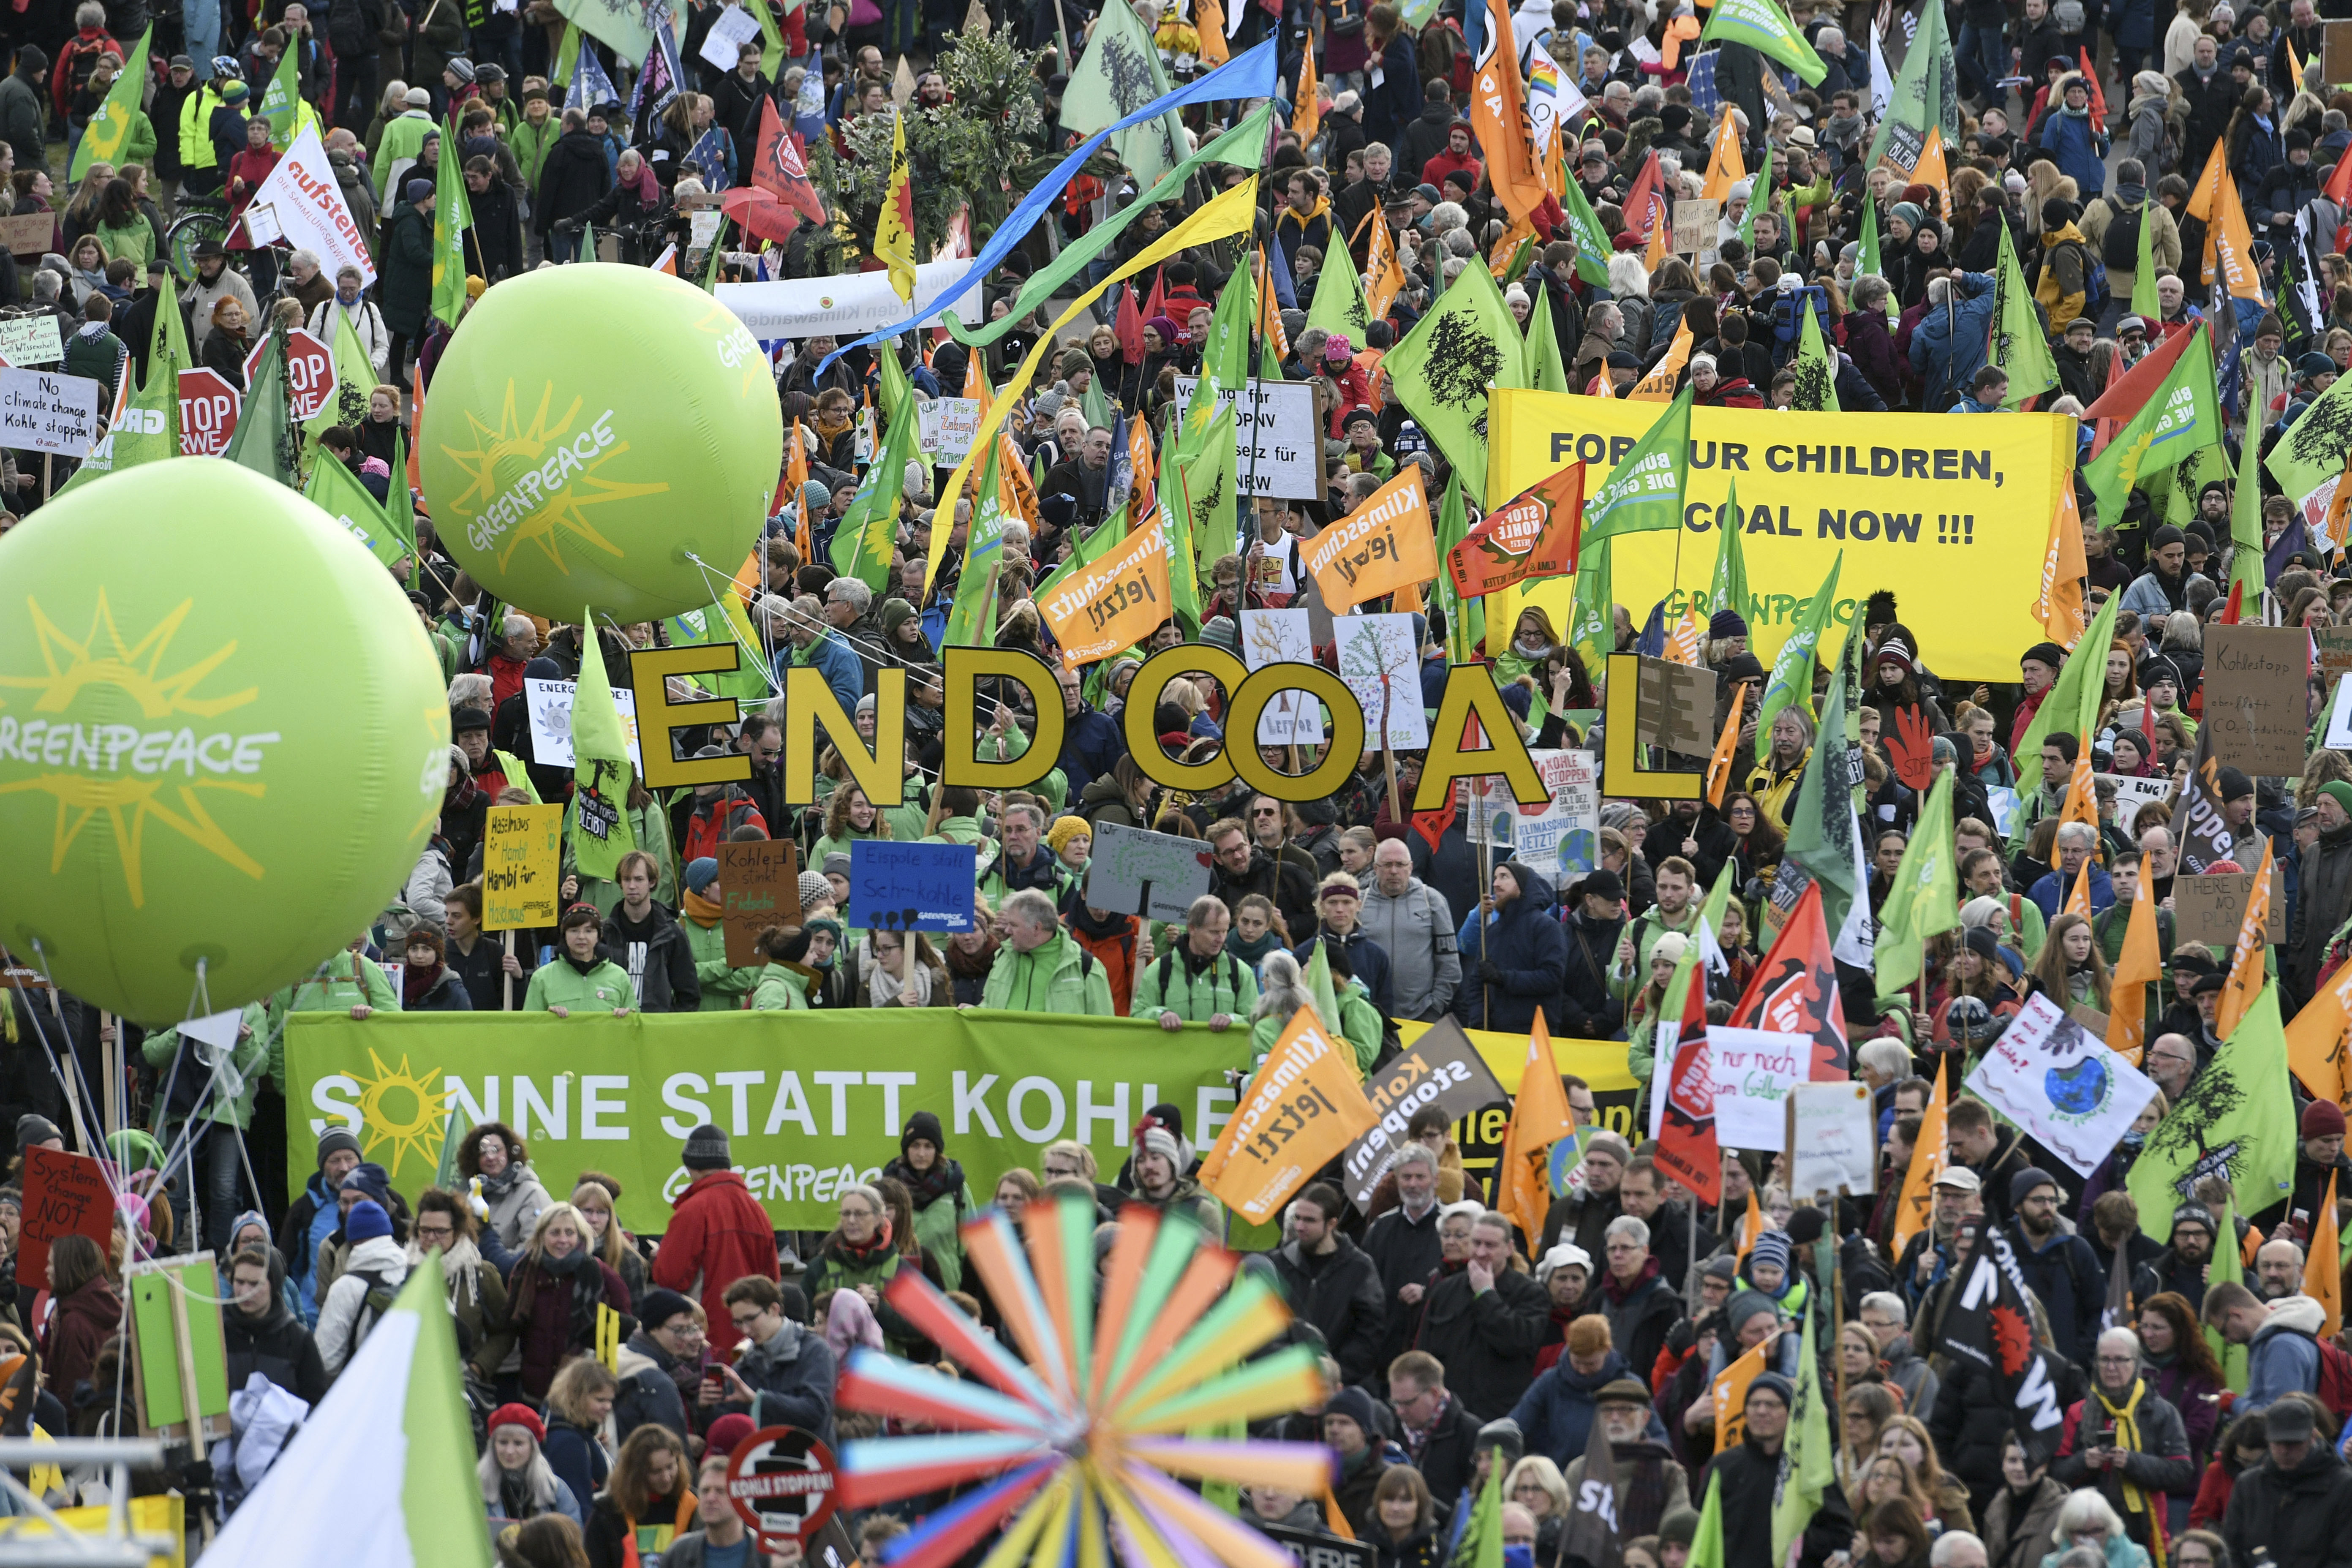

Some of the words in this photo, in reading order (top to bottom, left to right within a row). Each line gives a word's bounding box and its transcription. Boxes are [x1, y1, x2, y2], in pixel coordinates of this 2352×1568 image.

[277, 176, 291, 195] DIE
[288, 160, 377, 274] aufstehen
[1703, 206, 1715, 218] den
[287, 191, 352, 269] SAMMLUNGSBEWEG
[38, 377, 59, 396] No
[4, 390, 47, 411] climate
[51, 398, 87, 427] change
[178, 395, 231, 433] TOP
[953, 401, 970, 414] Die
[5, 412, 38, 430] Kohle
[45, 419, 93, 444] stoppen!
[941, 415, 978, 435] Zukunf
[44, 440, 60, 449] attac
[954, 433, 969, 444] ist
[1275, 445, 1297, 463] für
[1550, 431, 1638, 466] FOR
[1688, 439, 1750, 472] UR
[1764, 444, 2004, 488] CHILDREN,
[467, 409, 616, 552] GREENPEACE
[2315, 481, 2333, 498] KOHLE
[1683, 501, 1803, 537] COAL
[1817, 508, 1923, 543] NOW
[1937, 514, 1975, 545] !!!
[2216, 641, 2289, 676] Kohlestopp
[0, 716, 282, 776] REENPEACE
[1546, 754, 1578, 771] KOHLE
[1547, 767, 1591, 785] STOPPEN!
[599, 805, 618, 822] FORST
[1518, 816, 1579, 836] KLIMASCHUTZ
[1520, 831, 1557, 851] JETZT!
[725, 848, 770, 867] Kohle
[487, 863, 518, 892] Hambi
[741, 866, 778, 885] stinkt
[2183, 877, 2232, 894] THERE
[2239, 877, 2252, 893] IS
[2216, 896, 2235, 910] NO
[2270, 909, 2280, 927] B
[1755, 1045, 1797, 1076] noch
[660, 1069, 917, 1141] STATT
[33, 1152, 98, 1188] System
[47, 1183, 93, 1204] change
[38, 1196, 87, 1229] NOT
